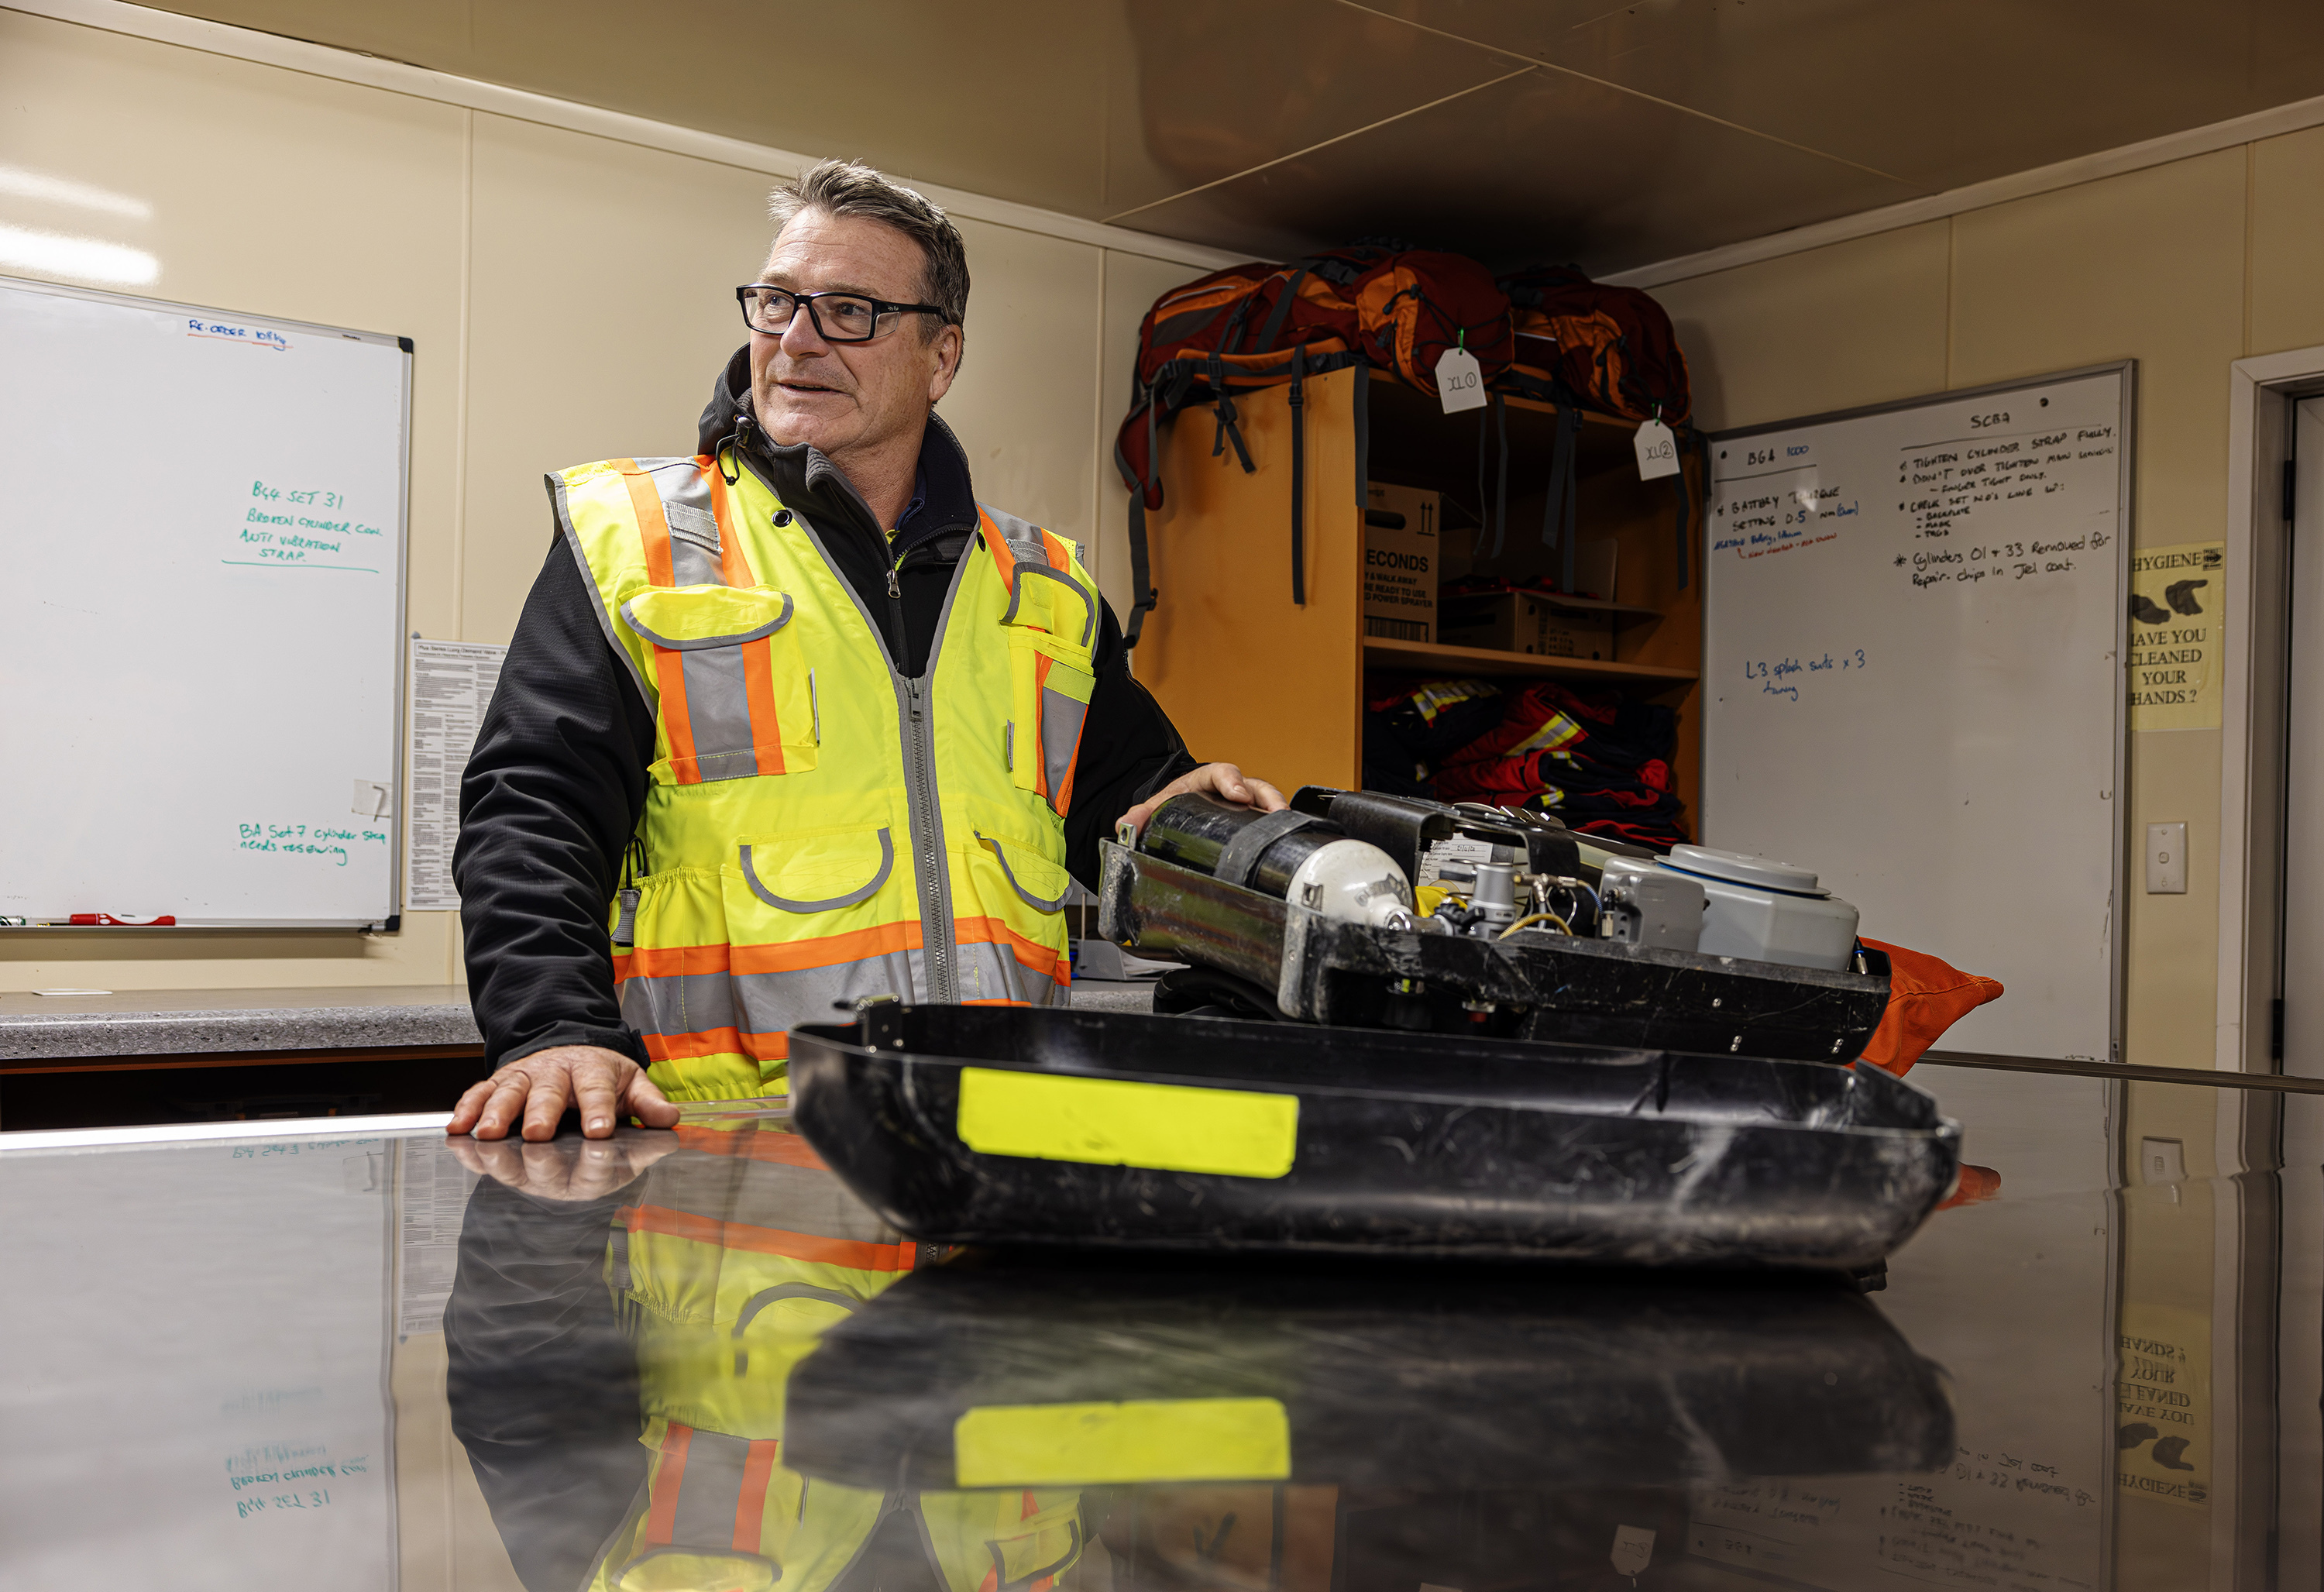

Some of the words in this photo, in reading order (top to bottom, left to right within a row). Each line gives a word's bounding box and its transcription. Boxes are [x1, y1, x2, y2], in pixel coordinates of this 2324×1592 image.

[1913, 453, 1958, 470] TIGHTEN
[1966, 442, 2020, 460] CYLINDER
[2031, 432, 2067, 449] STRAP
[1960, 462, 1986, 477] OVER
[1995, 457, 2040, 473] TIGHTEN
[287, 490, 321, 505] SET
[322, 491, 343, 511] 31
[1731, 497, 1779, 514] BATTERY
[246, 507, 294, 527] BROKEN
[298, 517, 352, 535] CYLINDER
[1732, 516, 1776, 532] SETTING
[239, 528, 274, 543] ANTI
[279, 535, 342, 553] VIBRATION
[1366, 548, 1429, 573] ECONDS
[1913, 549, 1964, 572] Cylinders
[2005, 542, 2025, 558] 33
[2031, 535, 2086, 555] Removed
[2090, 531, 2113, 551] for
[2132, 551, 2203, 573] HYGIENE
[2171, 628, 2207, 645] YOU
[1855, 648, 1865, 669] 3
[2142, 669, 2187, 686] YOUR
[2130, 689, 2186, 707] HANDS
[239, 822, 262, 839] BA
[268, 824, 294, 839] Set
[296, 824, 307, 837] 7
[239, 839, 277, 852] needs
